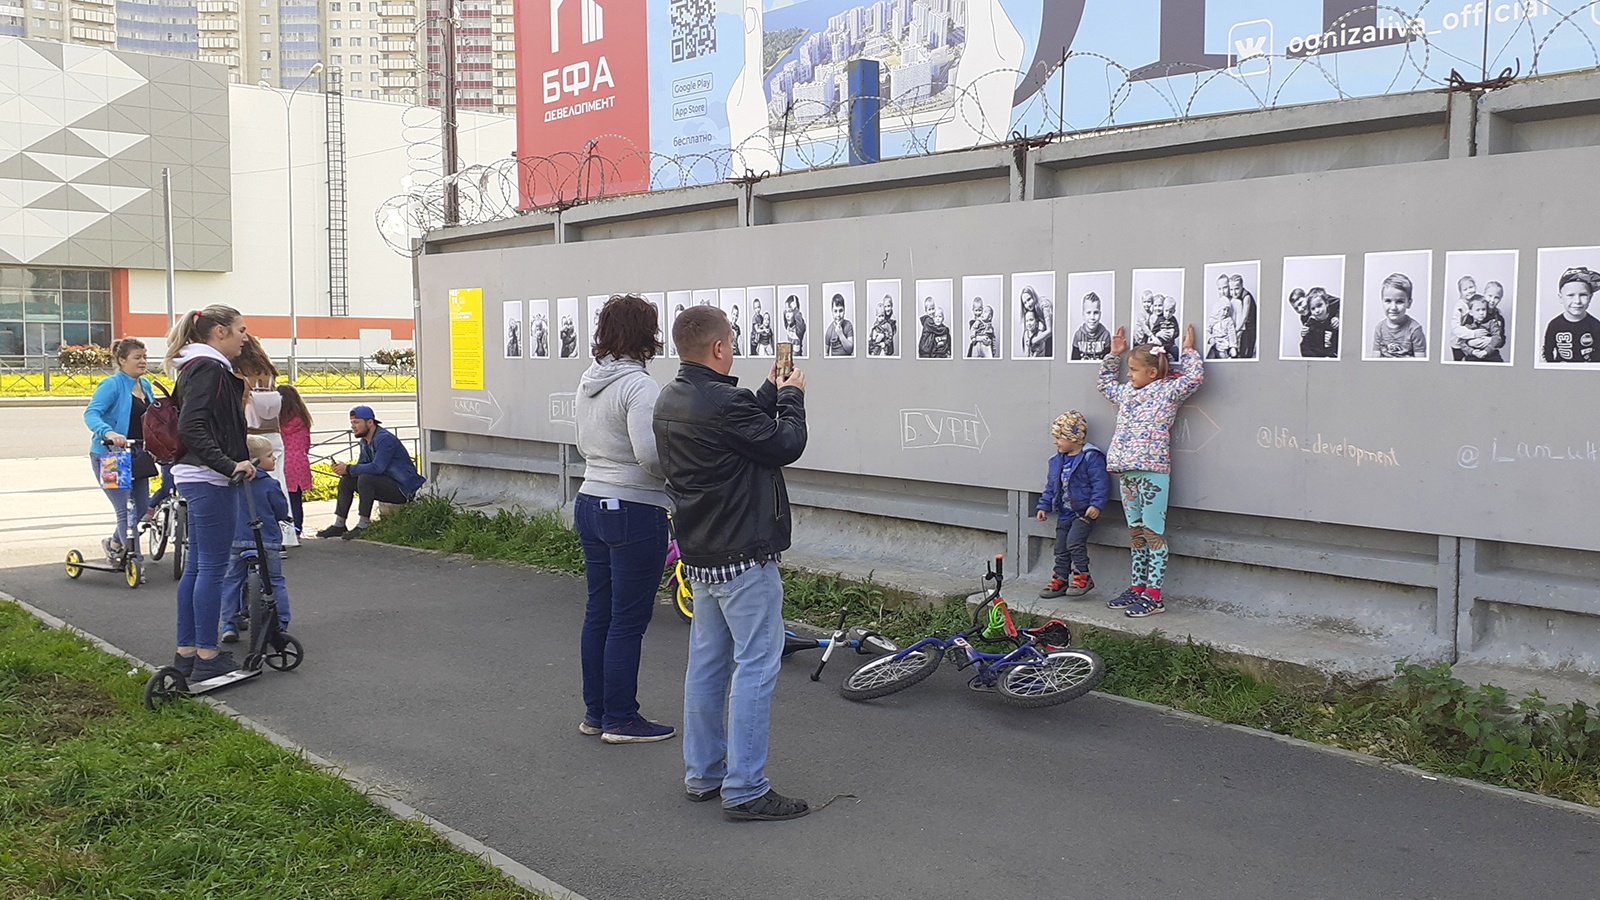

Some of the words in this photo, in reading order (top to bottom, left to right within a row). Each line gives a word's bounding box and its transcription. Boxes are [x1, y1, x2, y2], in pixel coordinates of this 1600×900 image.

[543, 56, 615, 104] БФА
[674, 81, 697, 94] Google
[697, 79, 711, 89] Play
[544, 95, 616, 122] ДЕВЕЛОПМЕНТ
[675, 107, 688, 117] App
[688, 104, 705, 114] Store
[673, 133, 712, 147] бесплатно
[904, 412, 980, 446] БУФЕТ
